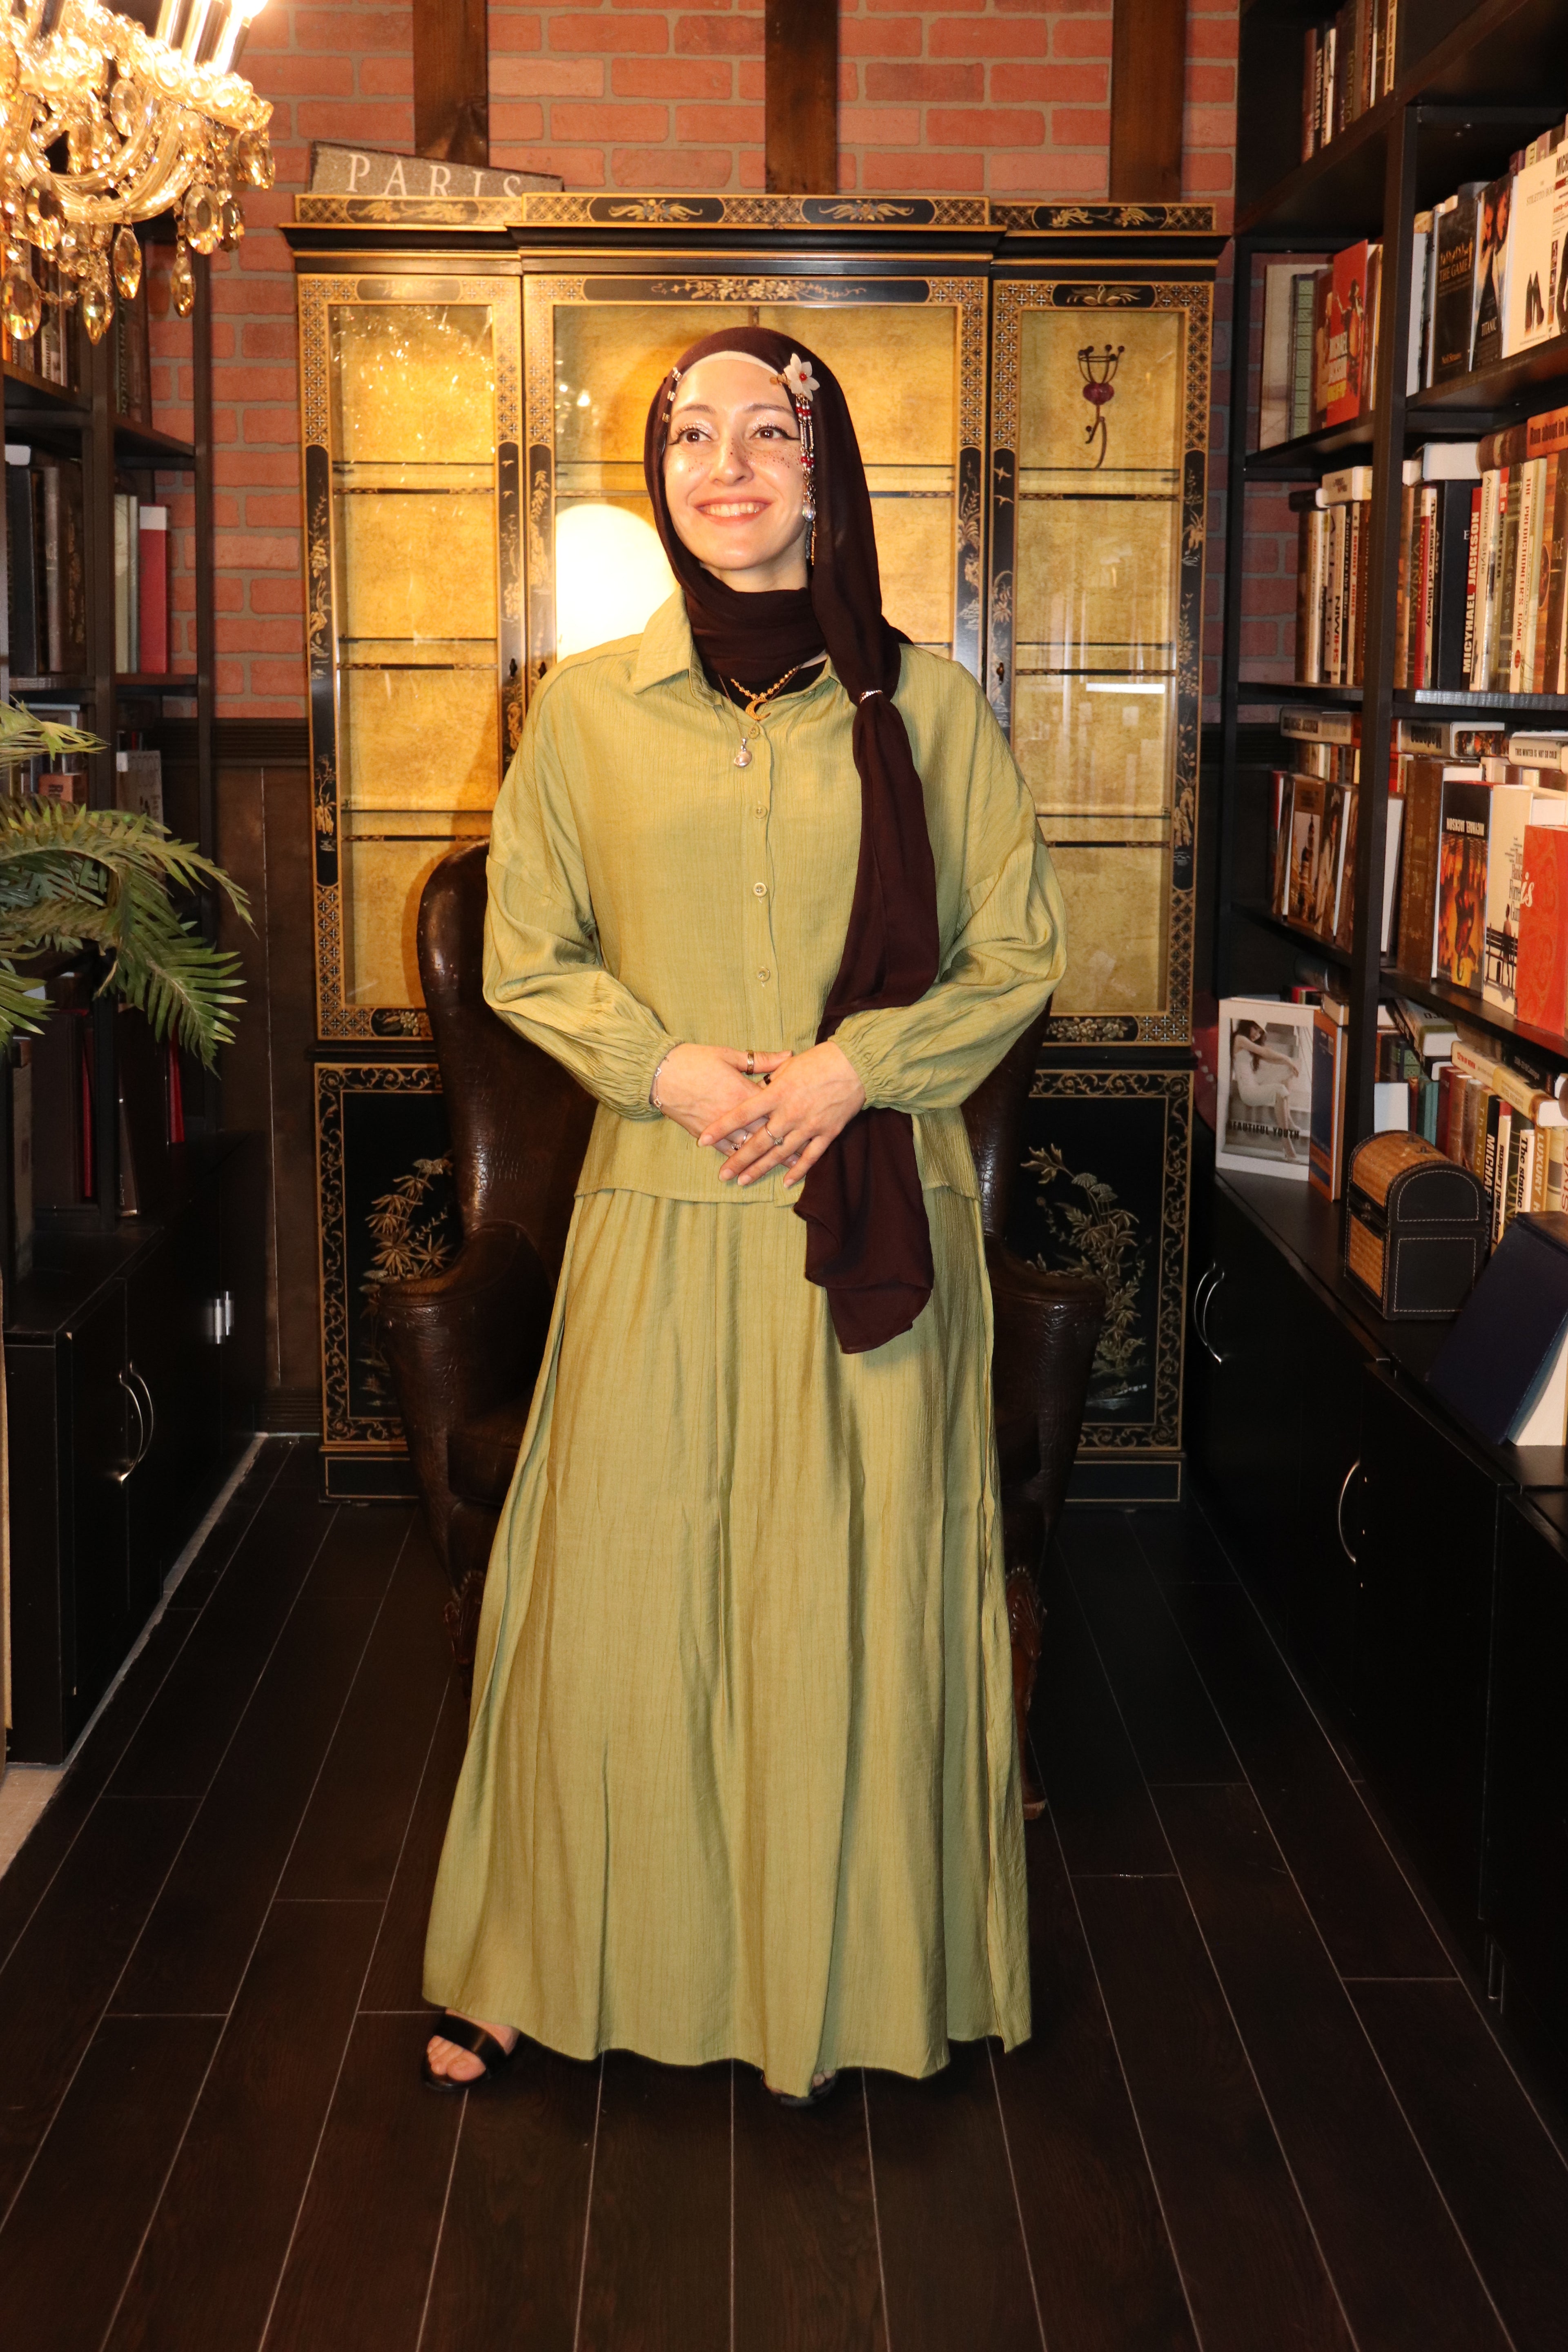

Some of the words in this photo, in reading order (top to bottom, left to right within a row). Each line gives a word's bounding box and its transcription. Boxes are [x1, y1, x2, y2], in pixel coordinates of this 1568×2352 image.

[345, 153, 521, 197] PARIS
[1451, 258, 1469, 277] GAME
[1481, 316, 1497, 336] TITANIC
[1468, 512, 1479, 586] JACKSON
[1428, 570, 1433, 581] of
[1463, 592, 1476, 673] MICYHAEL
[1522, 748, 1533, 757] WINTER
[1534, 749, 1537, 757] IS
[1549, 750, 1557, 759] COLD
[1227, 1121, 1269, 1135] BEAUTIFUL
[1273, 1127, 1300, 1140] YOUTH
[1534, 1132, 1544, 1196] LUXURY
[1517, 1167, 1525, 1208] statue
